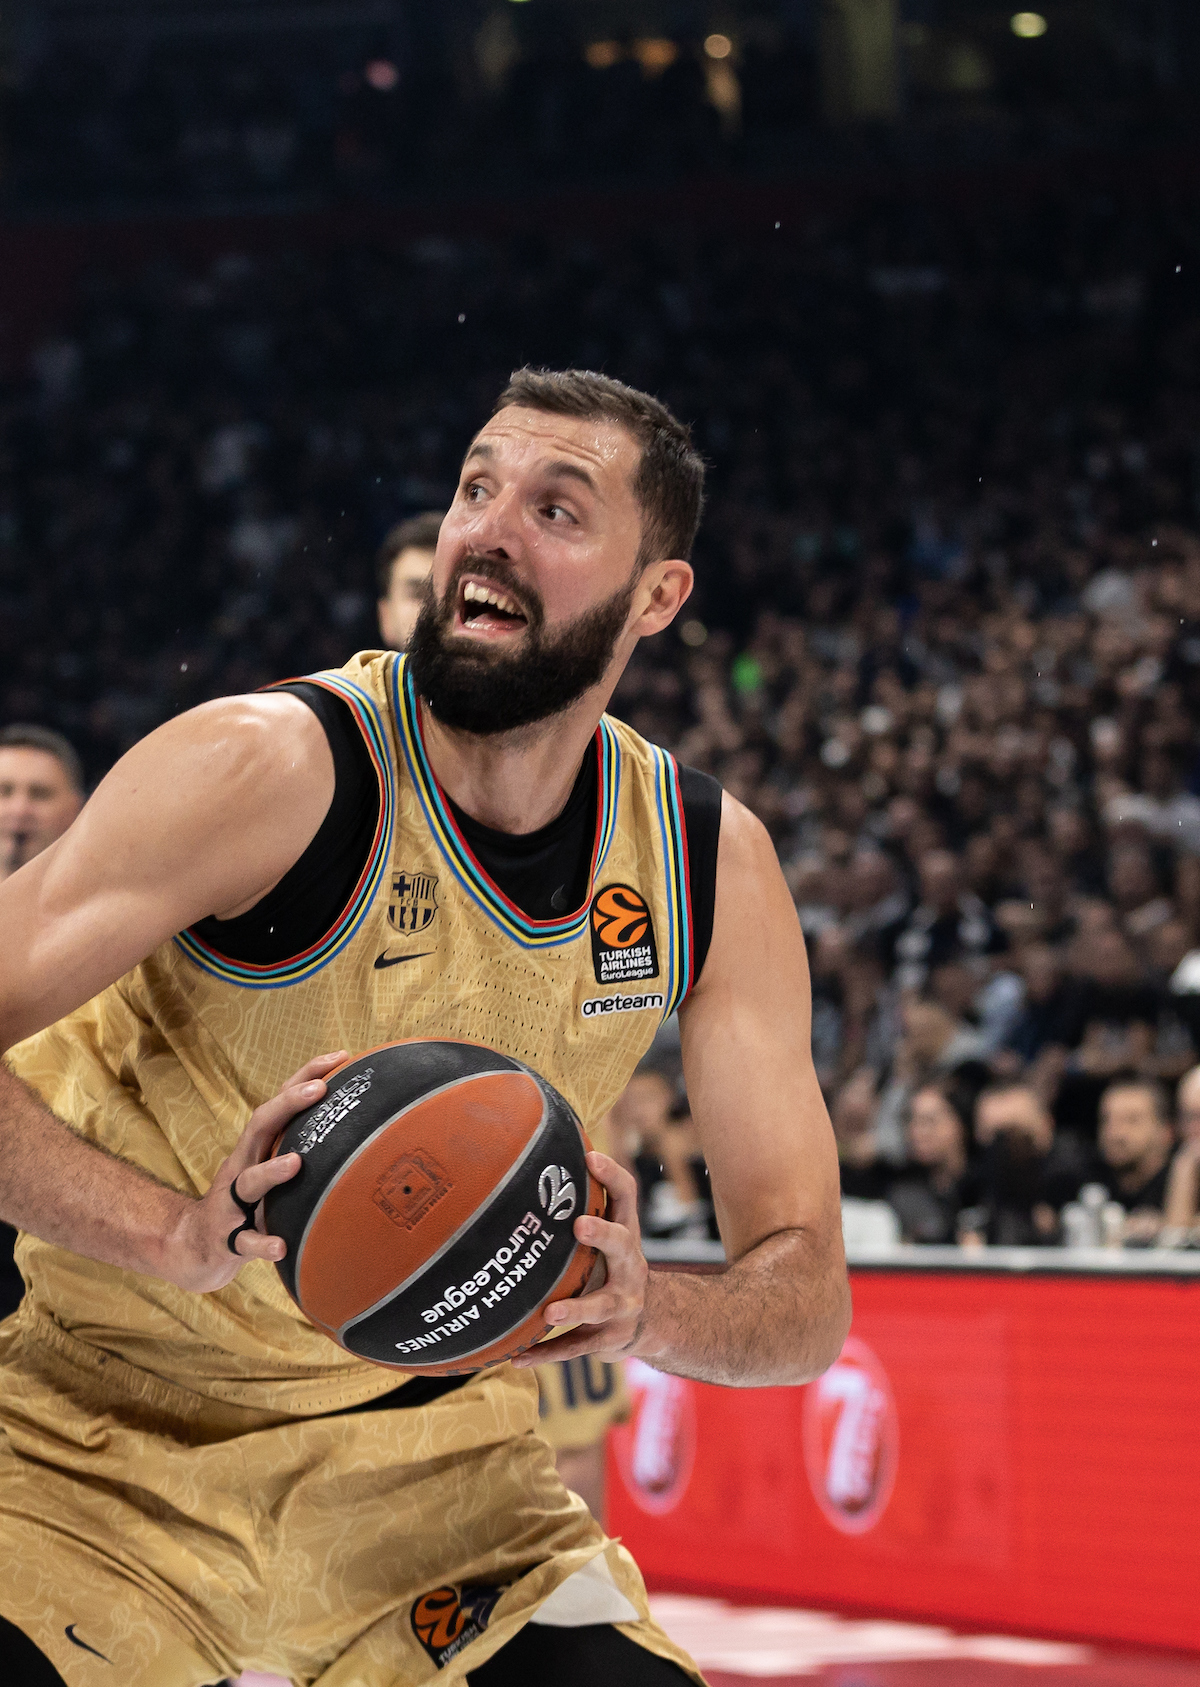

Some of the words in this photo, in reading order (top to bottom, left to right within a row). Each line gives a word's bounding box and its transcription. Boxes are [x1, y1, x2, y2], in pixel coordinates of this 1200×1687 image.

[599, 946, 651, 961] TURKISH
[600, 956, 652, 972] AIRLINES
[601, 967, 653, 981] EuroLeague
[583, 995, 663, 1015] oneteam
[421, 1211, 542, 1323] EuroLeague
[481, 1230, 554, 1308] TURKISH
[395, 1305, 481, 1353] AIRLINES
